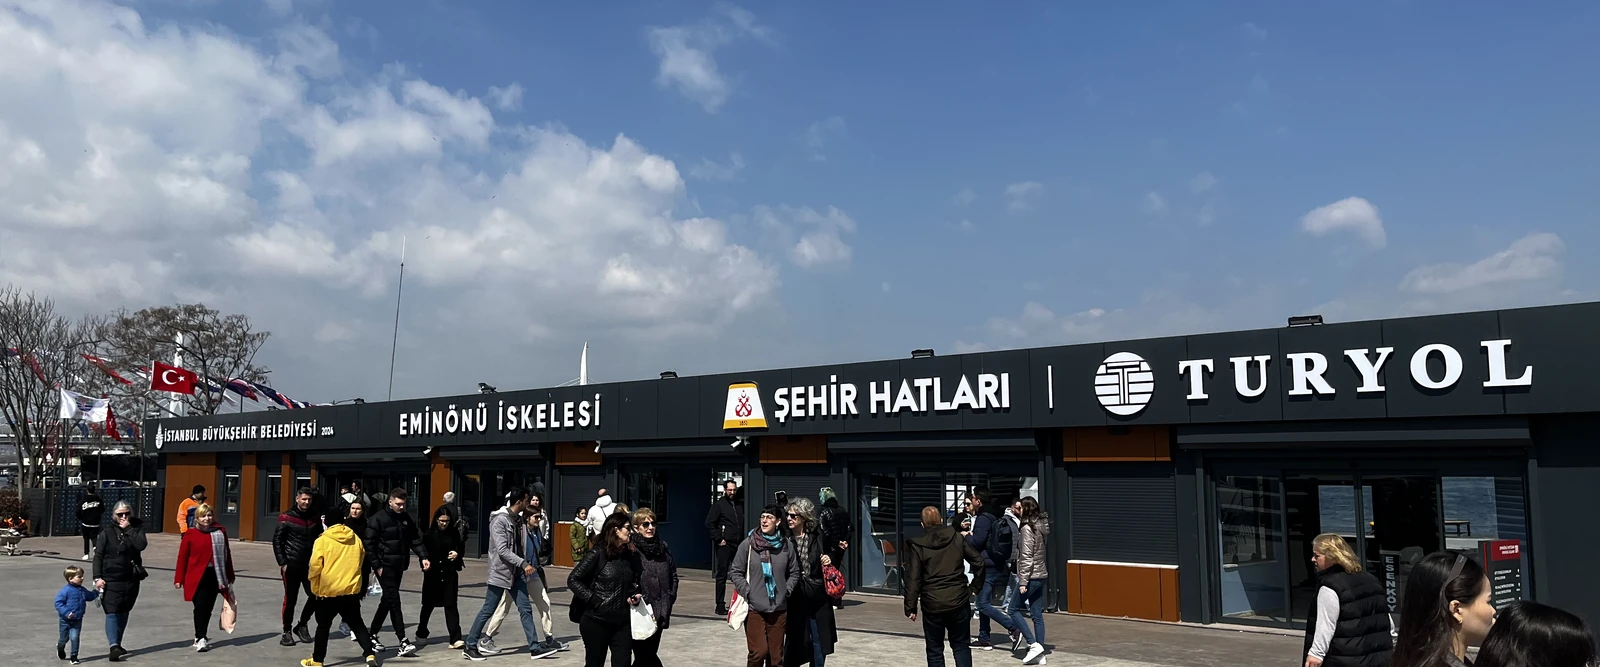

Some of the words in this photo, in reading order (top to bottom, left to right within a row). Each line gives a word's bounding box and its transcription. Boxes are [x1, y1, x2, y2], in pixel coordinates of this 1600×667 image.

[1178, 339, 1533, 400] TURYOL
[399, 402, 487, 436] EMİNÖNÜ
[498, 392, 600, 431] İSKELESİ
[774, 375, 859, 423] ŞEHİR
[869, 372, 1010, 414] HATLARI
[164, 428, 200, 442] İSTANBUL
[202, 424, 257, 441] BÜYÜKŞEHİR
[260, 419, 317, 438] BELEDİYESİ
